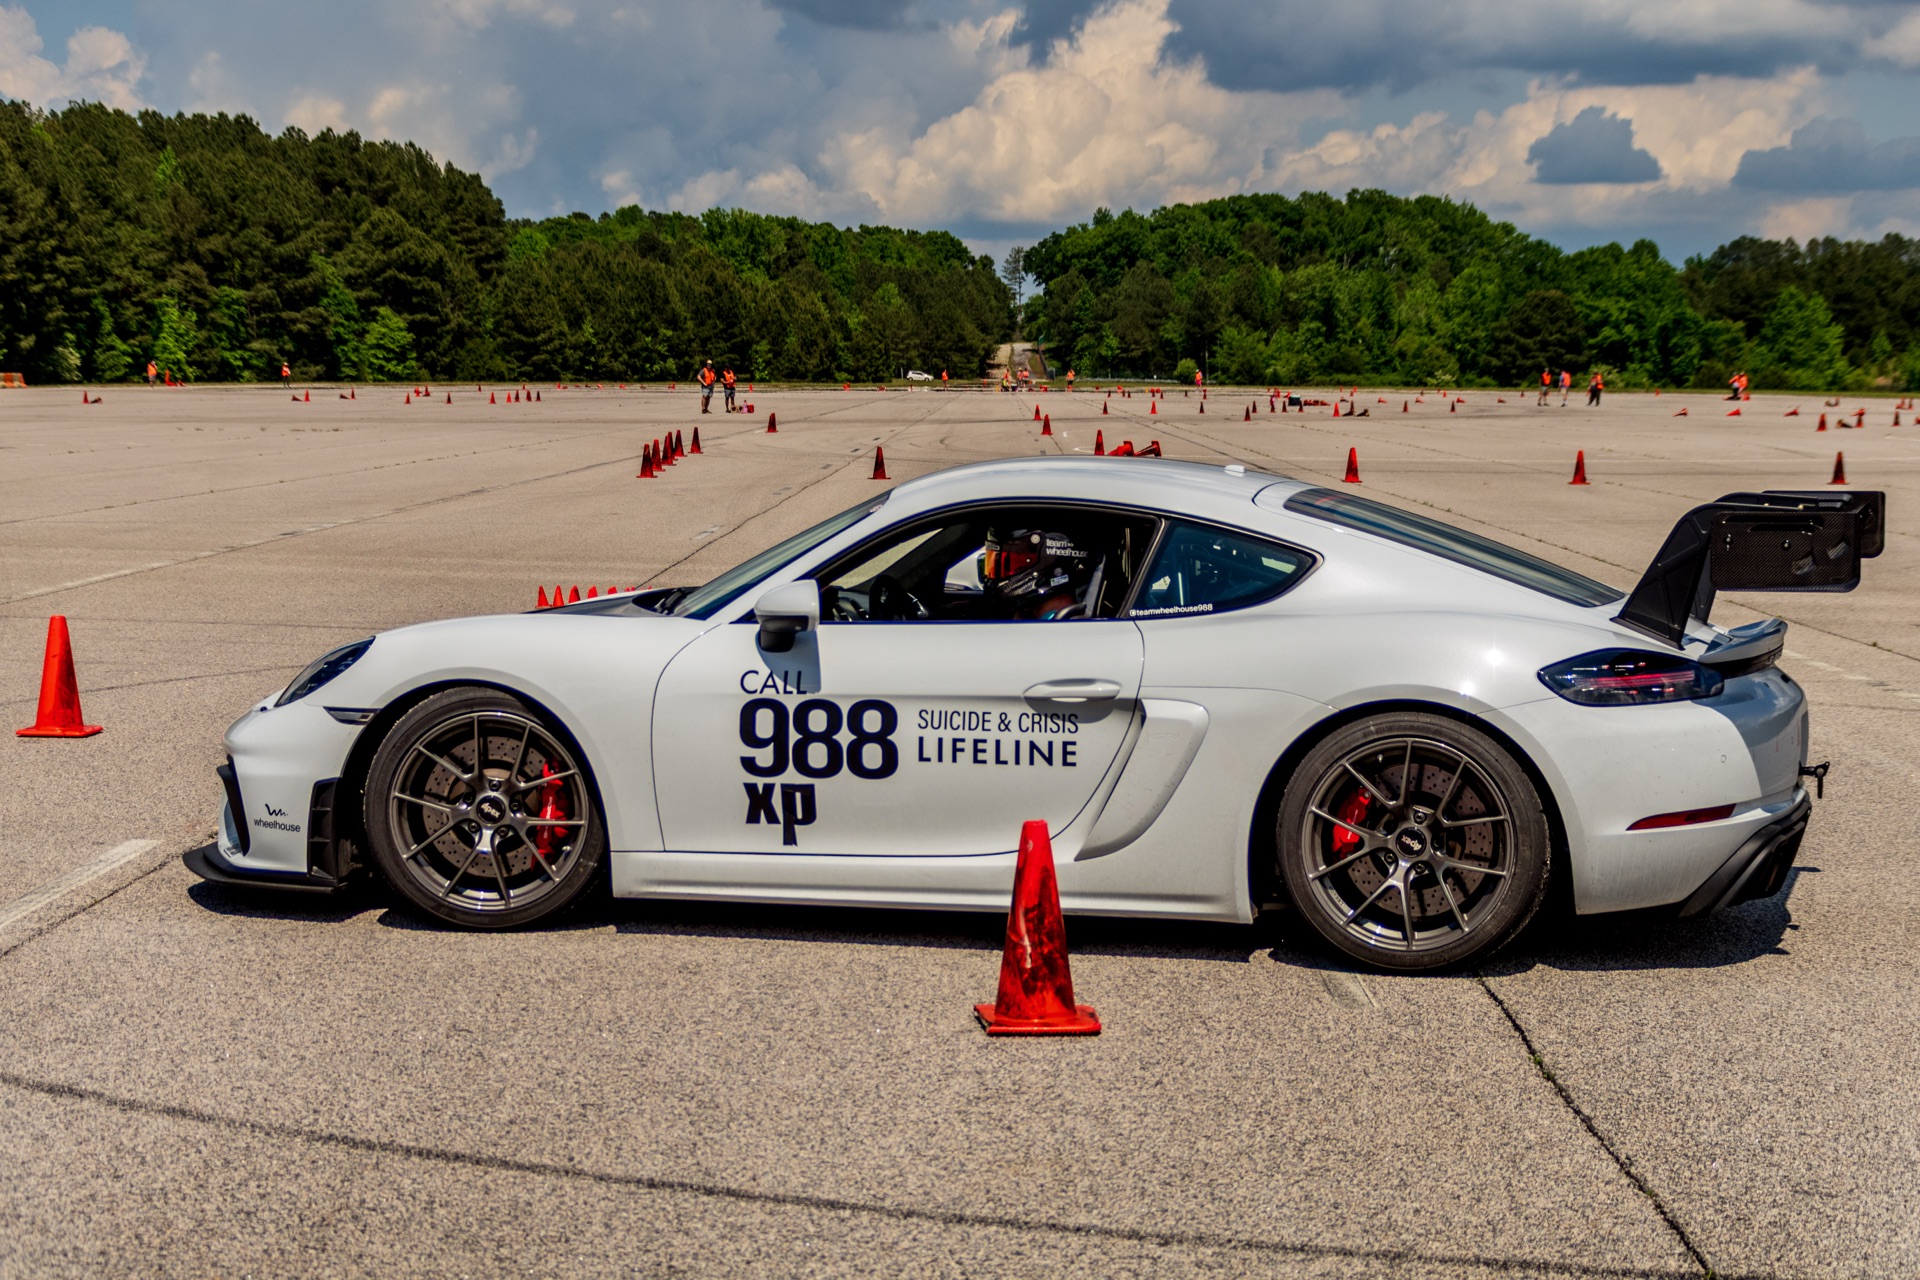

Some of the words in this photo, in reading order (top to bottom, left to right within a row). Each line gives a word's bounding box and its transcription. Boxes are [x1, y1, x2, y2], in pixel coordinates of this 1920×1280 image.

[1046, 539, 1067, 548] team
[1129, 603, 1213, 617] @teamwheelhouse988
[740, 670, 808, 695] CALL
[918, 709, 992, 732] SUICIDE
[997, 712, 1012, 733] &
[1018, 712, 1079, 734] CRISIS
[739, 697, 899, 780] 988
[917, 736, 1078, 767] LIFELINE
[253, 818, 301, 832] wheelhouse
[743, 782, 818, 847] xp
